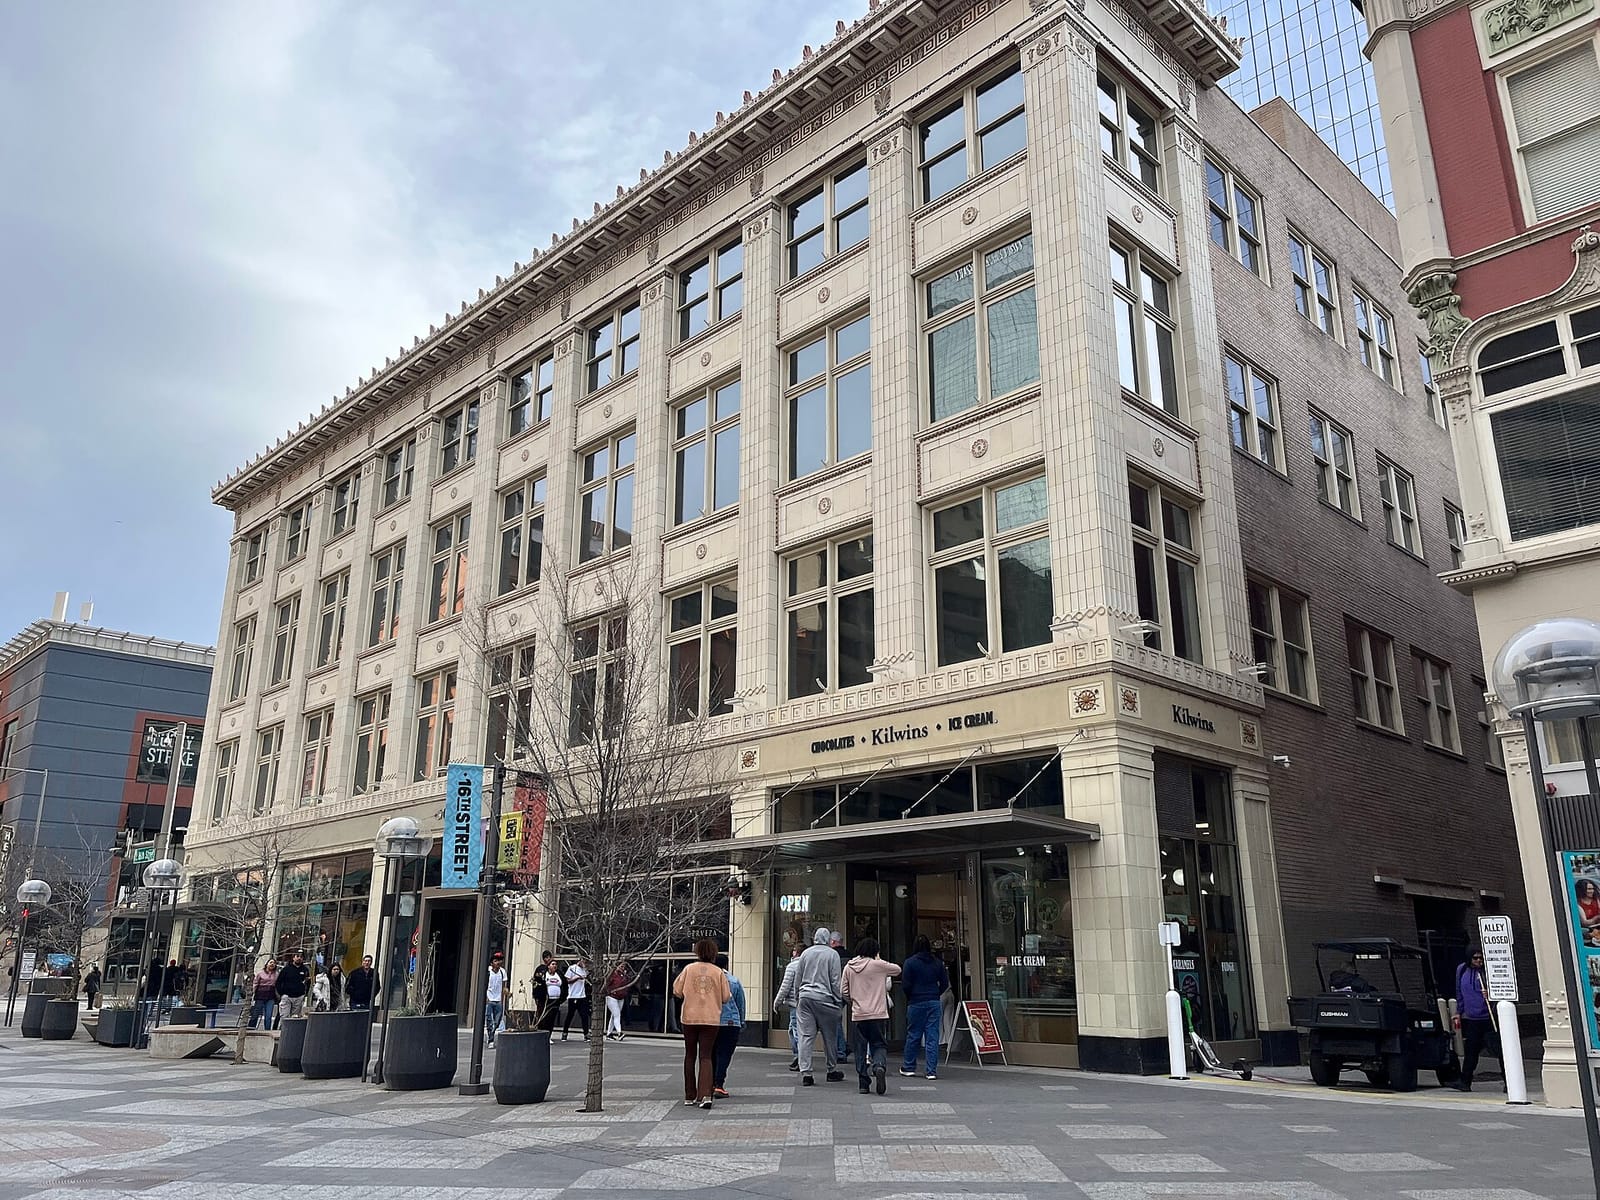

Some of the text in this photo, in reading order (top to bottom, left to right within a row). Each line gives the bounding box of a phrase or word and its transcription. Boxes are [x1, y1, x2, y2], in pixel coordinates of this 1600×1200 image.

[1172, 704, 1214, 733] Kilwins
[811, 711, 994, 754] CHOCOLATES Kilwins ICE CREAM
[454, 812, 471, 875] STREET
[780, 895, 810, 912] OPEN
[1484, 924, 1505, 932] ALLEY
[1484, 936, 1509, 944] CLOSED
[1011, 955, 1046, 967] ICE CREAM
